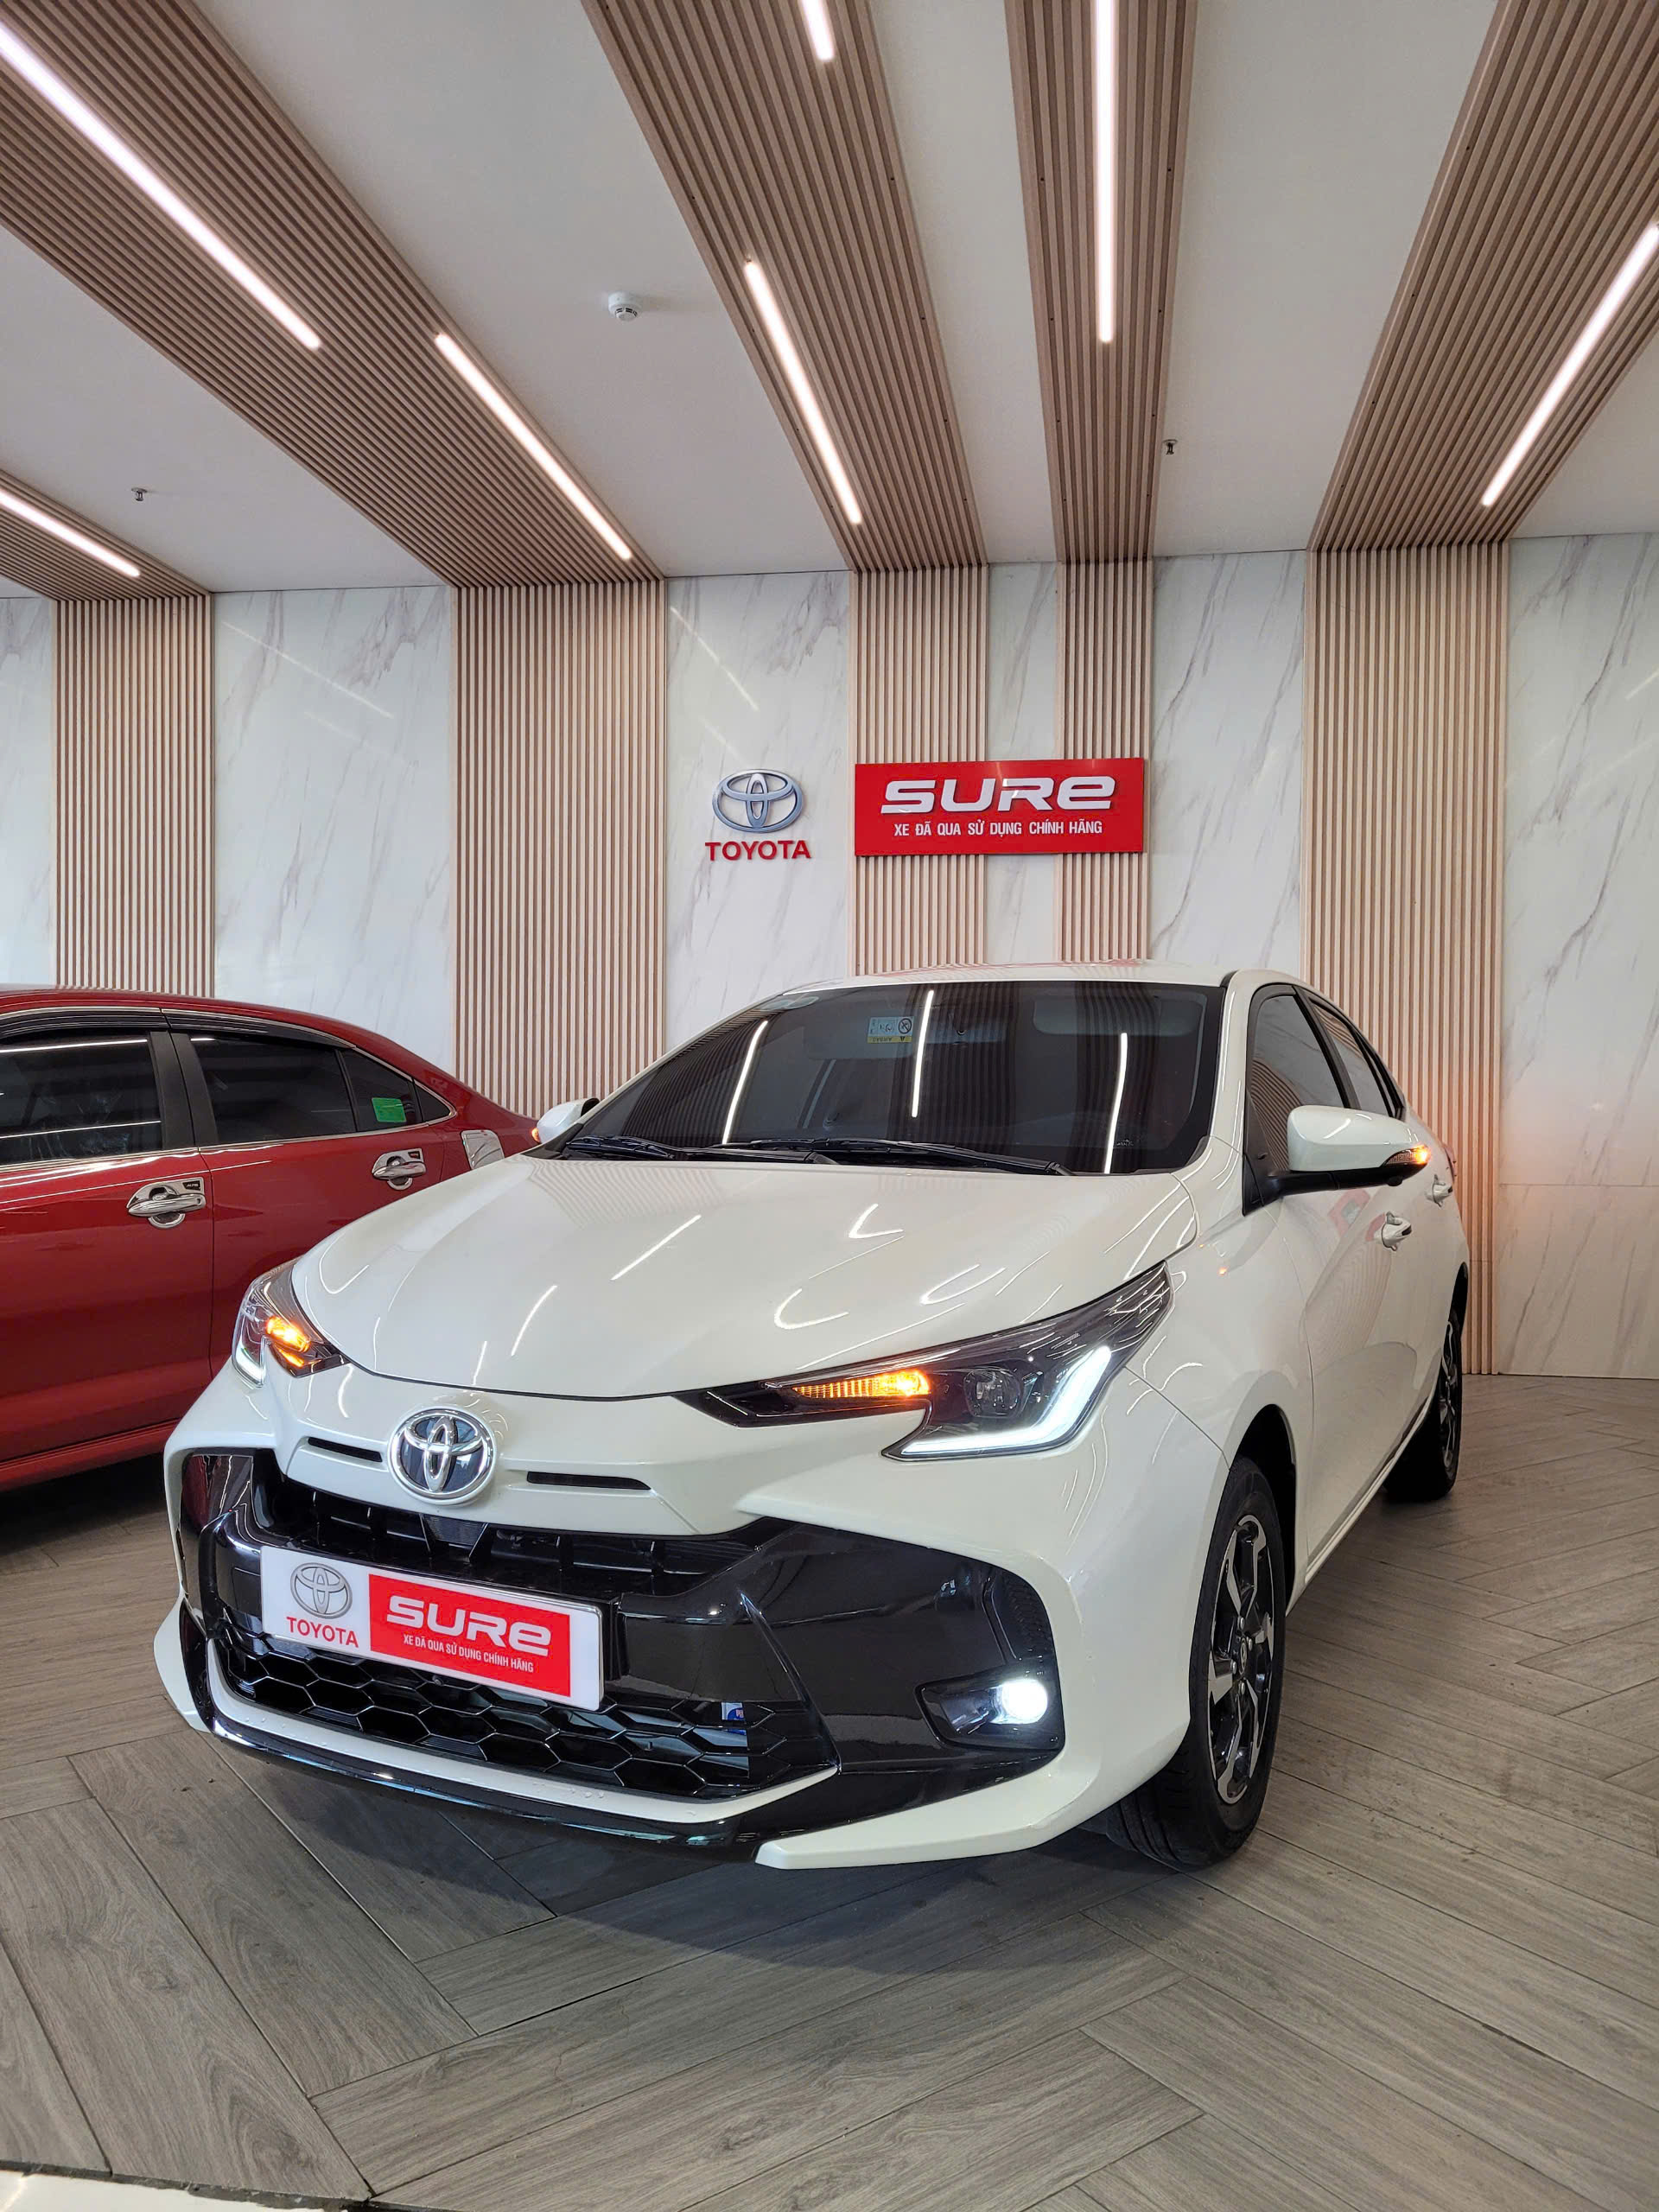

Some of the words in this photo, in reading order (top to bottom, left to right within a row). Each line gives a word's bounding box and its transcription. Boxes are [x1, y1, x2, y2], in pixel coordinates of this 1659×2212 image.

[893, 823, 910, 836] XE
[915, 821, 932, 836] ĐÃ
[937, 823, 962, 836] QUA
[967, 819, 985, 836] SỬ
[989, 822, 1022, 837] DỤNG
[1029, 819, 1065, 835] CHÍNH
[1069, 818, 1103, 835] HÃNG
[704, 840, 811, 861] TOYOTA
[286, 1616, 359, 1649] TOYOTA
[403, 1634, 414, 1646] XE
[415, 1635, 426, 1649] ĐÃ
[428, 1639, 445, 1653] QUA
[458, 1646, 482, 1661] DỤNG
[483, 1651, 509, 1667] CHÍNH
